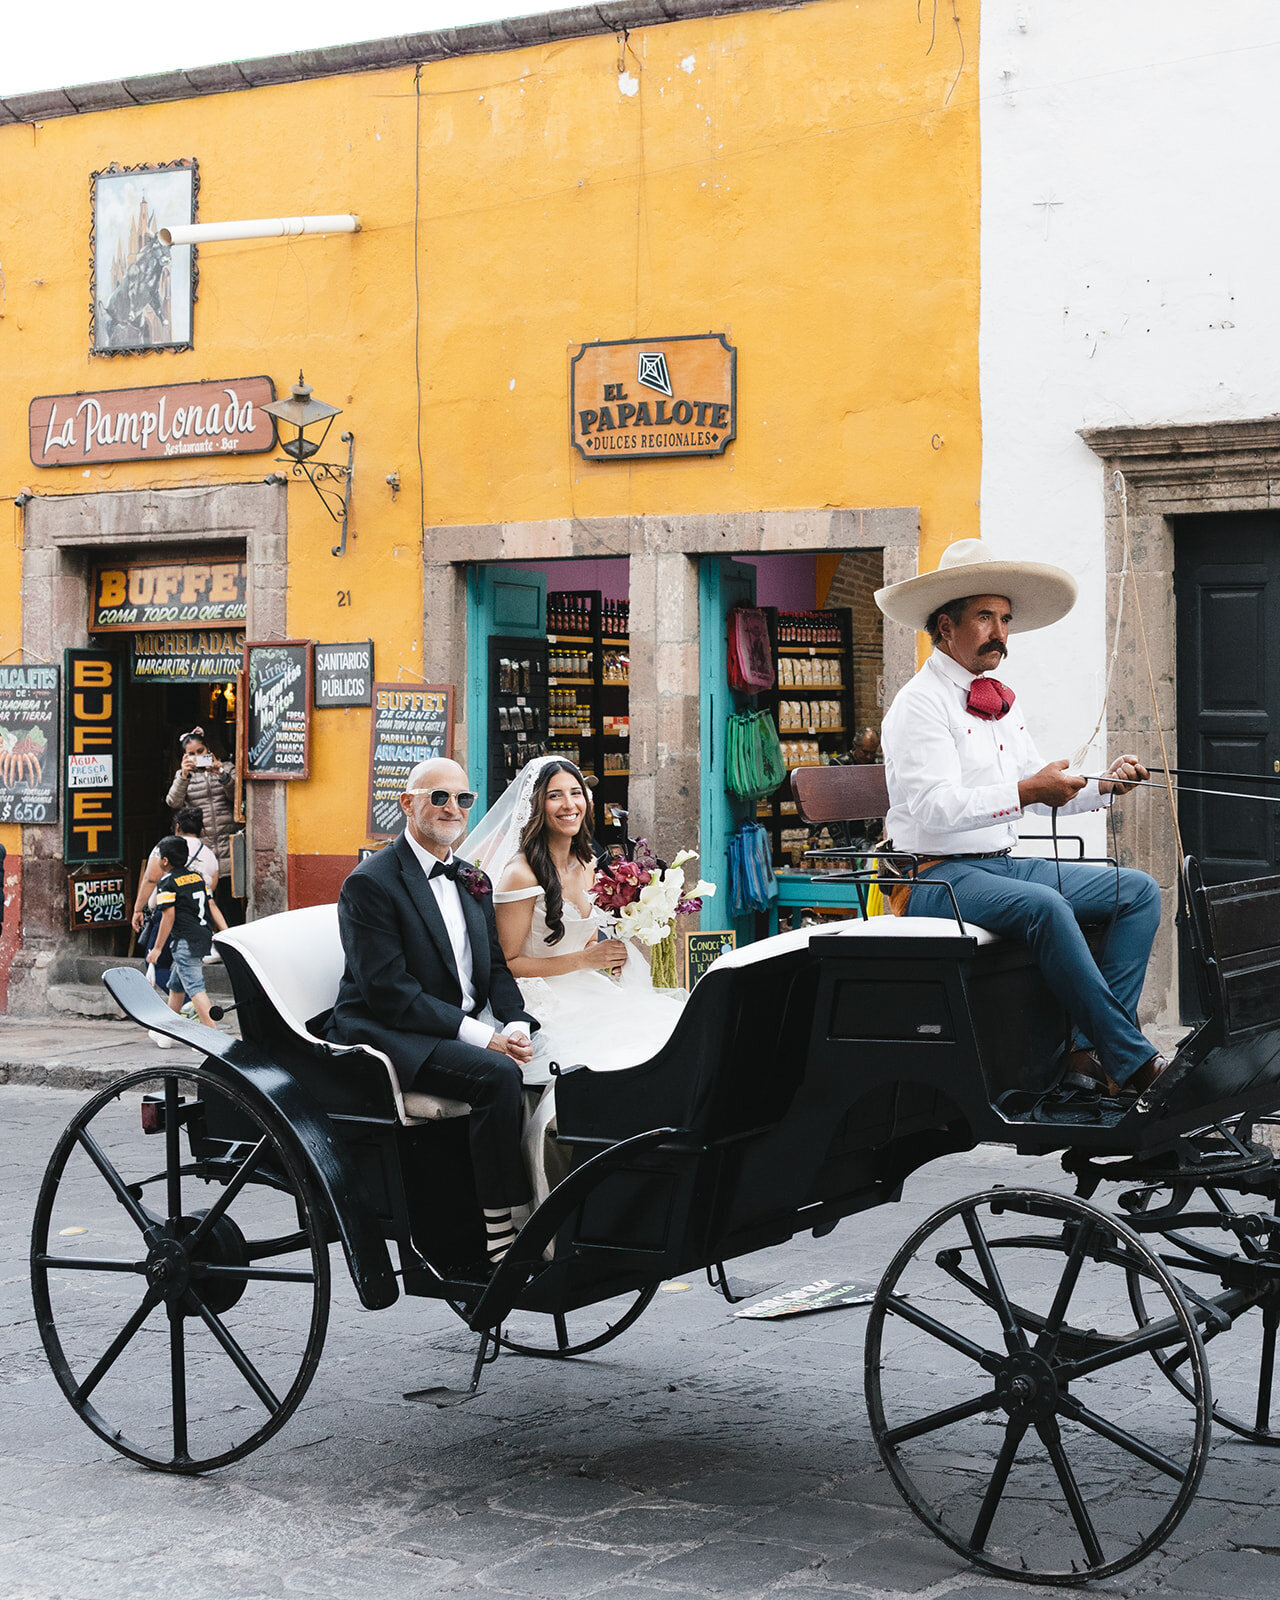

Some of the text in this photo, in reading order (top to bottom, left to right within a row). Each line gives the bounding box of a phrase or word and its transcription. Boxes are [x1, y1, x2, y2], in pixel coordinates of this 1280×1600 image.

[603, 383, 628, 401] EL
[43, 388, 256, 458] La Pamplonada
[579, 400, 729, 435] PAPALOTE
[164, 437, 239, 456] Restaurante Bar
[594, 432, 711, 450] DULCES REGIONALES
[98, 563, 247, 607] BUFFE
[336, 590, 351, 607] 21
[98, 608, 138, 624] COMA
[142, 605, 178, 622] TODO
[179, 605, 198, 620] LO
[198, 604, 225, 621] QUE
[134, 631, 246, 656] MICHELADAS
[135, 658, 190, 676] MARGARITAS
[197, 658, 241, 676] MOJITOS
[317, 652, 369, 672] SANITARIOS
[321, 674, 365, 698] PÚBLICOS
[43, 700, 52, 711] Y
[376, 691, 446, 712] BUFFET
[14, 711, 20, 721] Y
[22, 711, 53, 721] TIERRA
[286, 711, 305, 721] FRESA
[380, 710, 438, 720] DE CARNES
[281, 721, 306, 731] MANGO
[275, 731, 306, 742] DURAZNO
[380, 733, 428, 745] PARRILLADA
[73, 660, 113, 852] BUFET
[275, 742, 305, 753] JAMAICA
[374, 744, 440, 763] ARRACHERA
[275, 753, 305, 764] CLASICA
[74, 879, 123, 912] BUFFET
[88, 893, 125, 907] COMIDA
[83, 903, 123, 923] $245
[192, 890, 207, 926] 7
[689, 937, 720, 951] CONOCE
[690, 952, 700, 963] EL
[697, 963, 705, 973] DE
